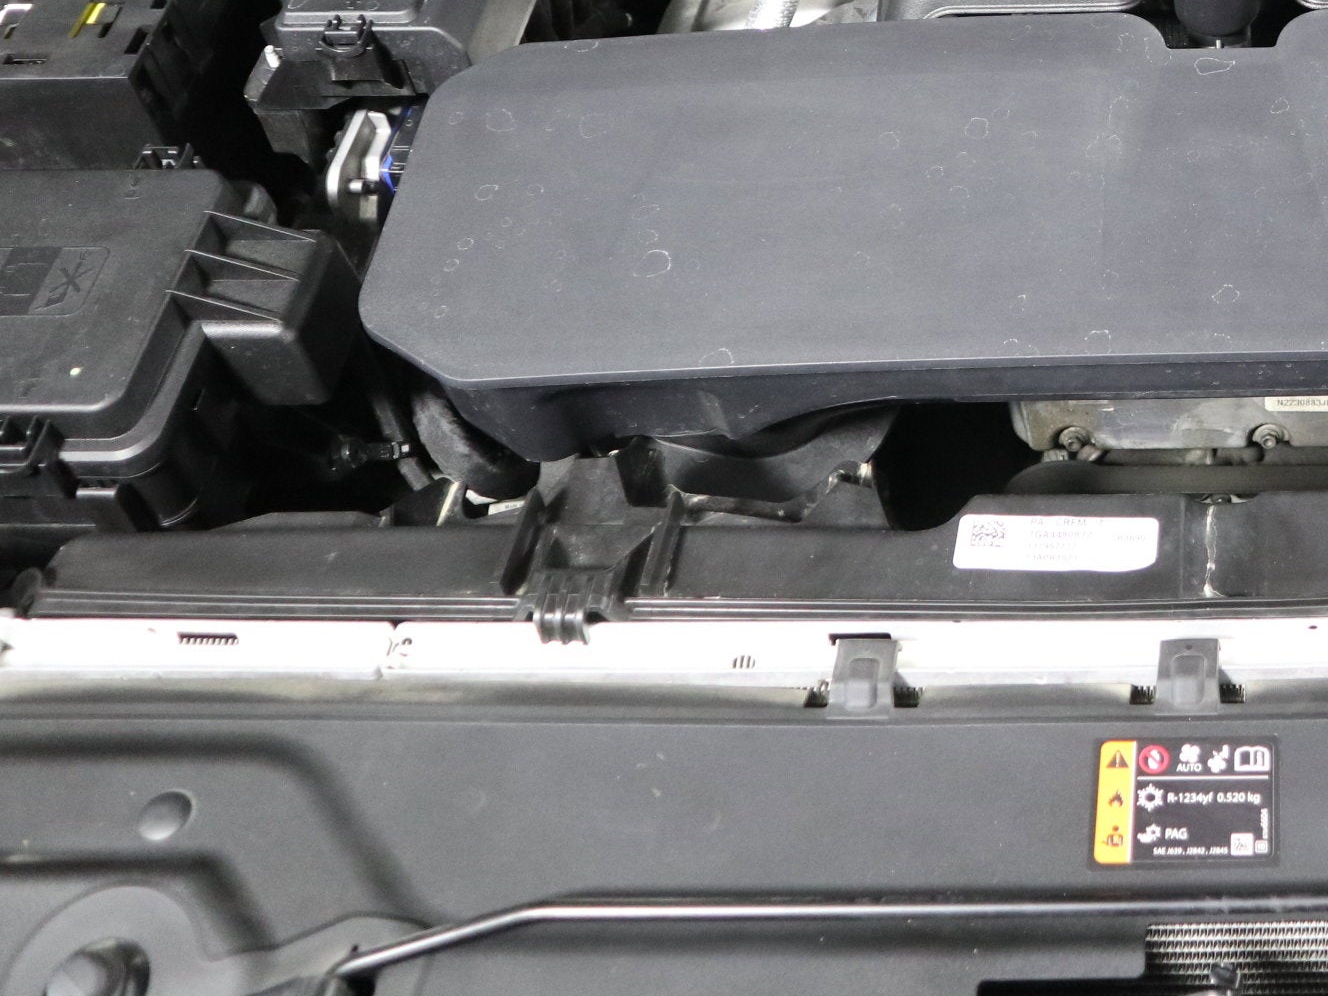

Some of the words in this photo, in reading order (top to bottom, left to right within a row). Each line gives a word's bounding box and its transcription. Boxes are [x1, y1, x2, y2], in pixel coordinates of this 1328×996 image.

[1176, 763, 1202, 773] AUTO
[1166, 792, 1212, 805] R-1234yf
[1217, 793, 1246, 803] 0.520
[1247, 793, 1261, 805] kg
[1164, 827, 1188, 840] PAG
